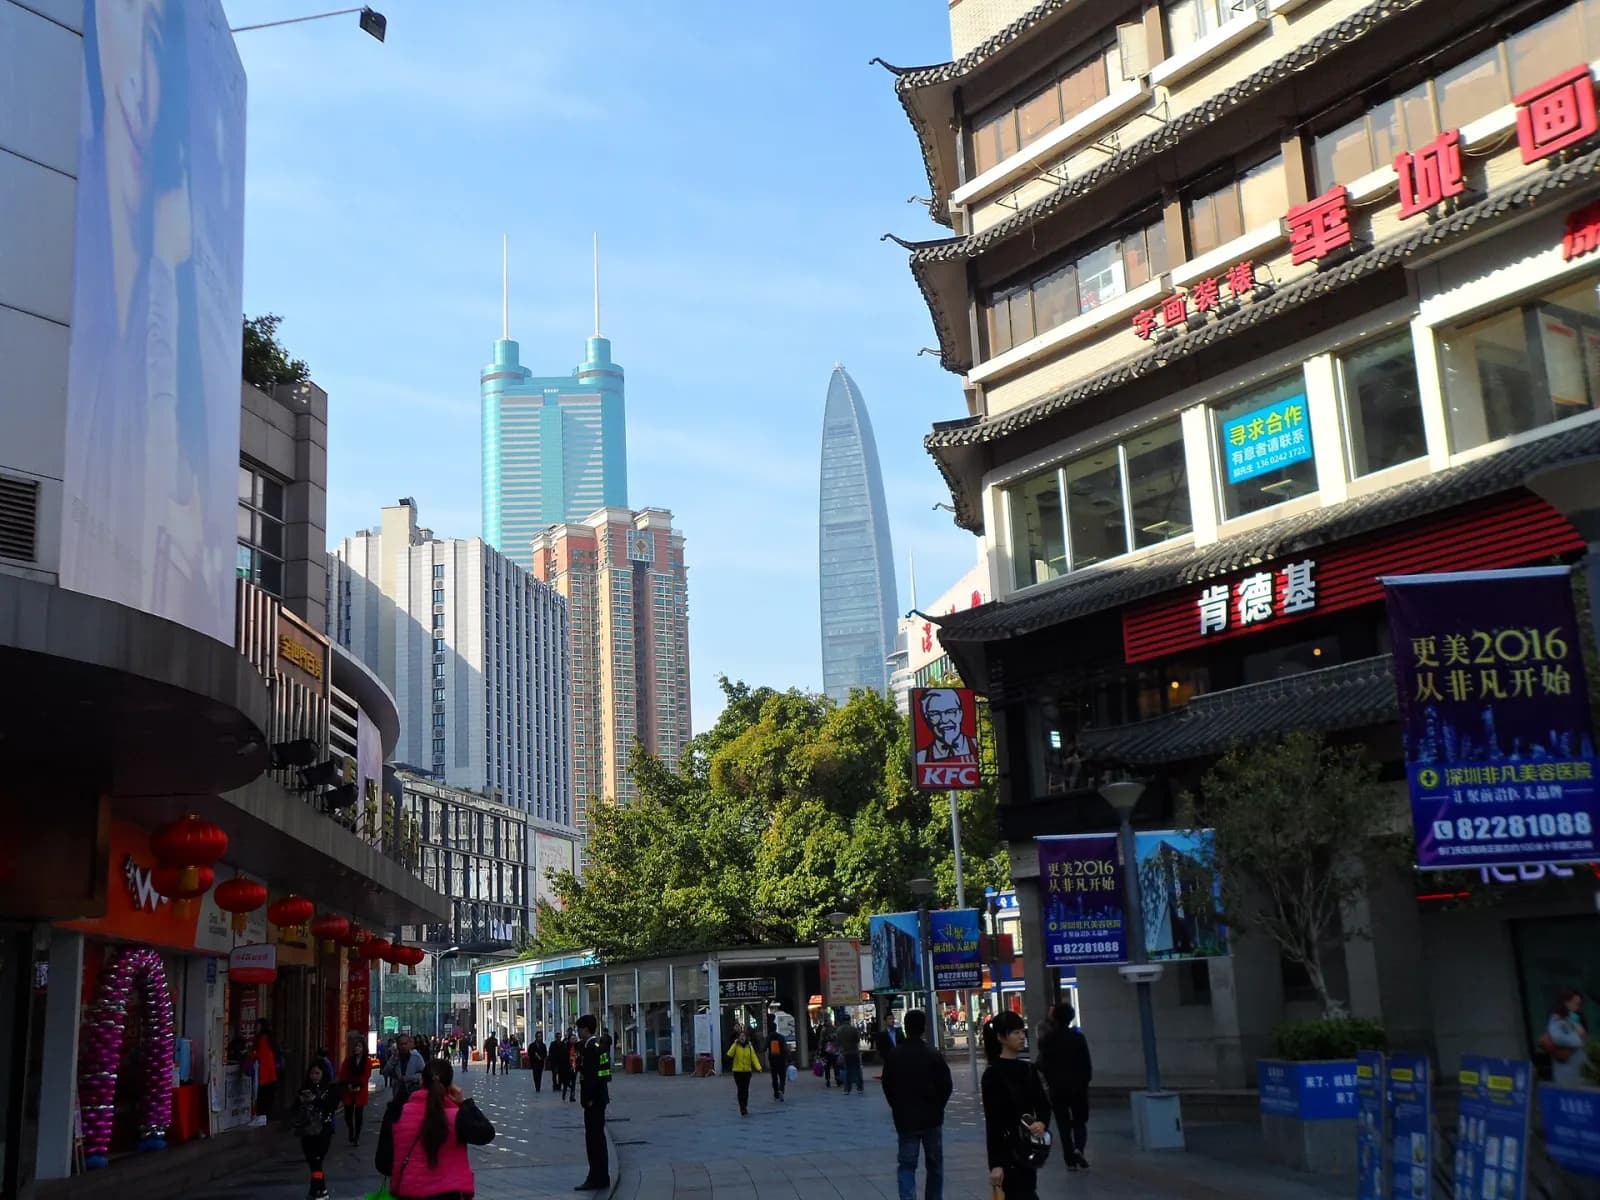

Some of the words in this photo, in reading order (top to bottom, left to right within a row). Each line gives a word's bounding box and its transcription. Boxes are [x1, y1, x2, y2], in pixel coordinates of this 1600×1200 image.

[1230, 405, 1302, 446] 寻求合作
[1232, 428, 1304, 465] 有意者请联系
[1197, 560, 1316, 635] 肯德基
[1411, 627, 1568, 668] 更美2016
[1416, 664, 1571, 701] 从非凡开始
[922, 767, 977, 785] KFC
[1445, 762, 1592, 786] 深圳非凡美容医院
[1457, 812, 1592, 840] 82281088
[1048, 876, 1115, 892] 从非凡开始
[1063, 942, 1119, 954] 82281088
